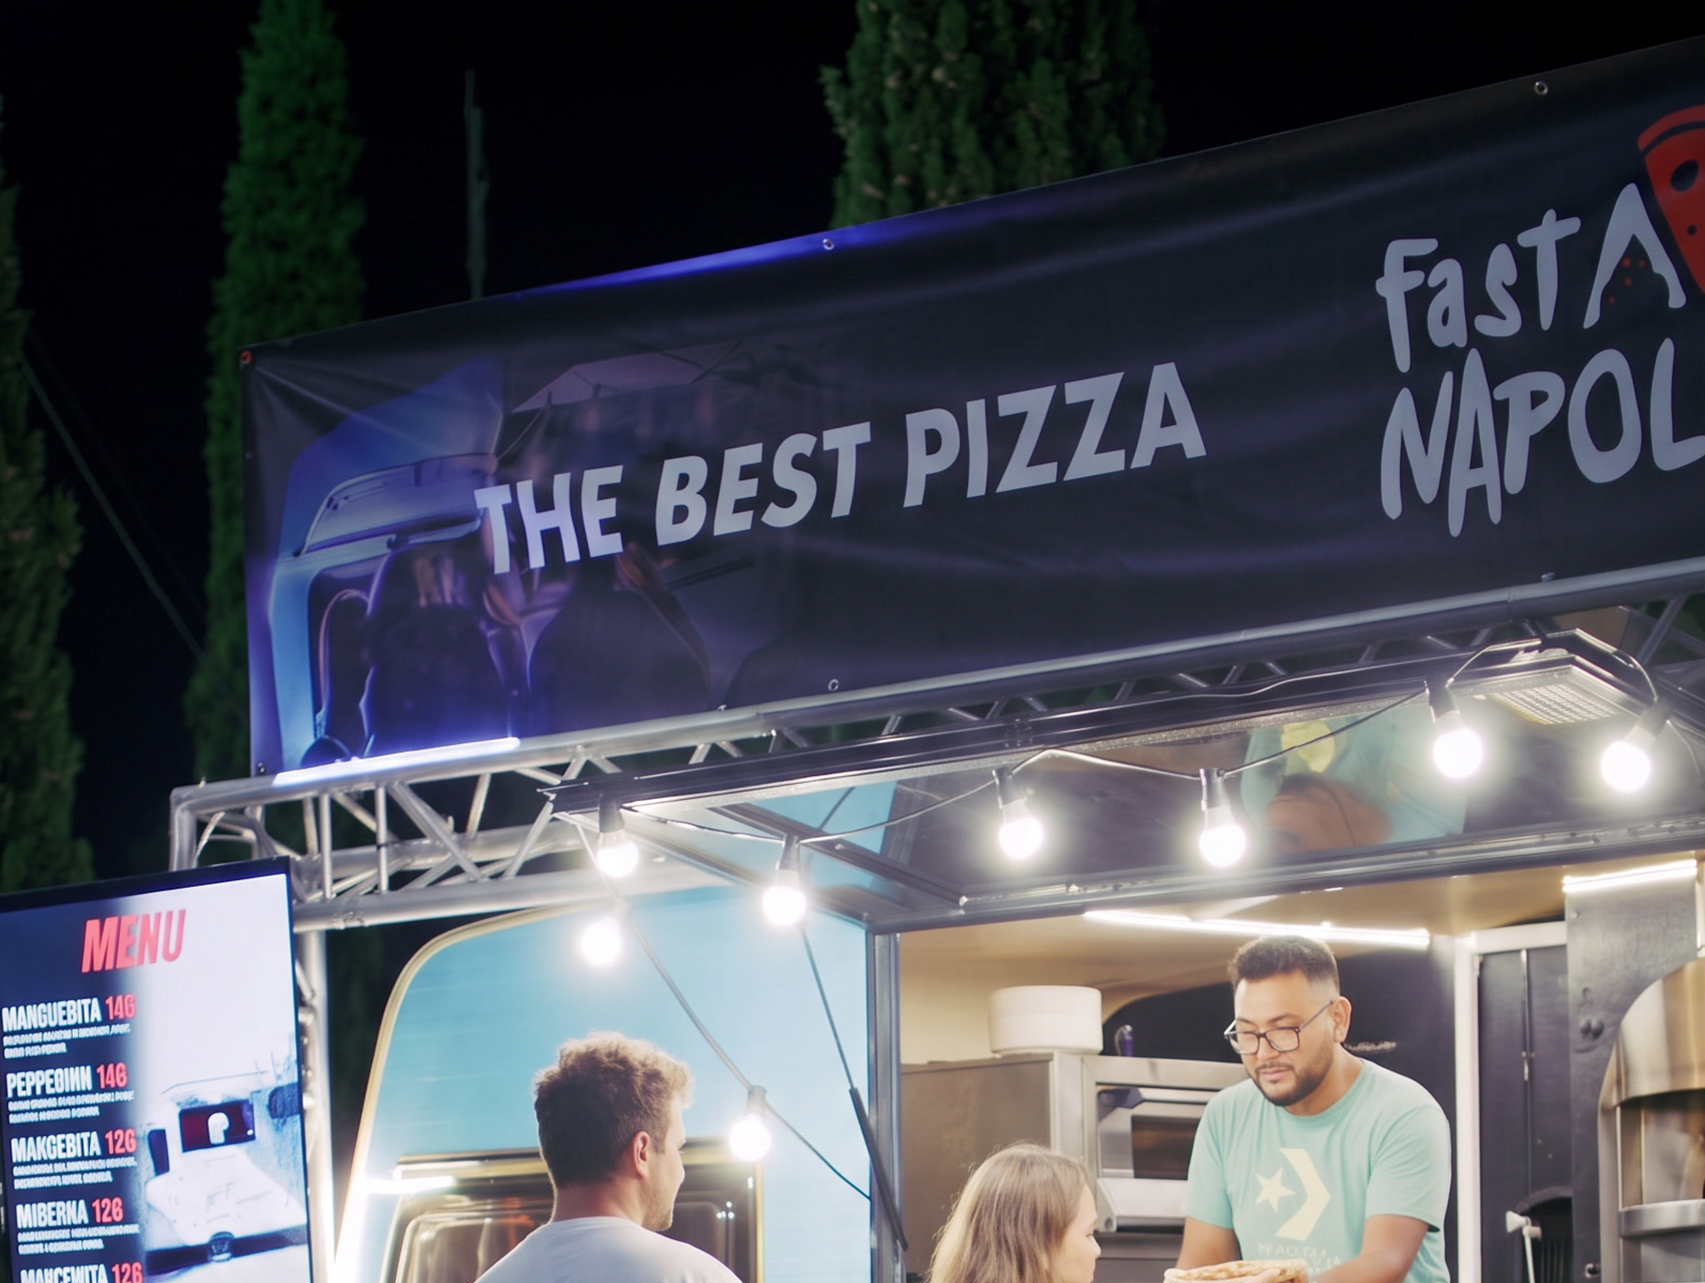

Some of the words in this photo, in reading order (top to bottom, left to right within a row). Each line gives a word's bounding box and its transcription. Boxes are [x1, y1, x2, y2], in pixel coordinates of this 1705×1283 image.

[474, 465, 624, 574] THE
[656, 421, 871, 545] BEST
[904, 362, 1207, 508] PIZZA
[81, 909, 186, 973] MENU
